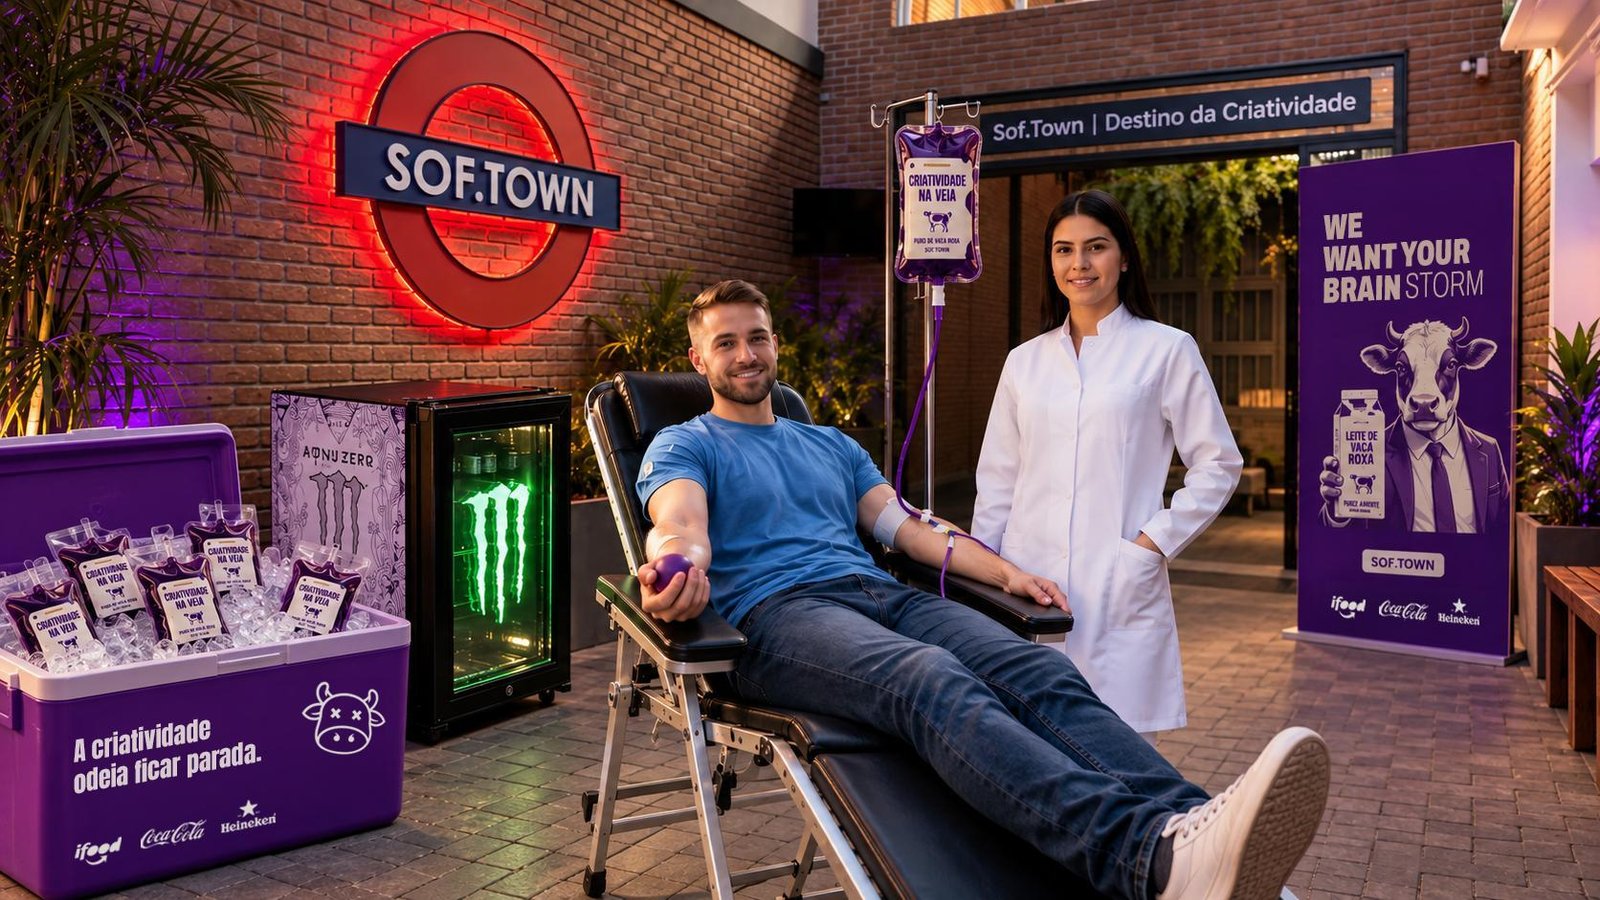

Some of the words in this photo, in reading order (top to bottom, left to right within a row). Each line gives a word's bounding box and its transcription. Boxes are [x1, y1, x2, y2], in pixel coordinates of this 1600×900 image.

[992, 118, 1084, 142] Sof.Town
[1105, 107, 1184, 132] Destino
[1190, 105, 1216, 124] da
[1222, 92, 1357, 121] Criatividade
[384, 142, 594, 217] SOF.TOWN
[908, 174, 967, 188] CRIATIVIDADE
[918, 188, 932, 202] NA
[935, 188, 957, 202] VEIA
[1323, 212, 1363, 240] WE
[1323, 243, 1397, 272] WANT
[1401, 238, 1470, 267] YOUR
[1323, 274, 1400, 304] BRAIN
[1405, 269, 1484, 299] STORM
[1345, 431, 1366, 441] LEITE
[1367, 431, 1378, 441] DE
[1350, 442, 1373, 453] VACA
[1348, 454, 1374, 465] ROXA
[1371, 556, 1435, 571] SOF.TOWN
[175, 600, 187, 610] NA
[1331, 595, 1367, 612] ifood
[1379, 600, 1429, 621] Coca-Cola
[1438, 612, 1480, 626] Heineken
[73, 738, 86, 763] A
[91, 718, 211, 761] criatividade
[73, 763, 129, 794] odeia
[134, 754, 181, 783] ficar
[186, 742, 262, 778] parada.
[74, 836, 122, 861] ifood
[139, 818, 208, 850] Coca-Cola
[220, 813, 277, 834] Heineken
